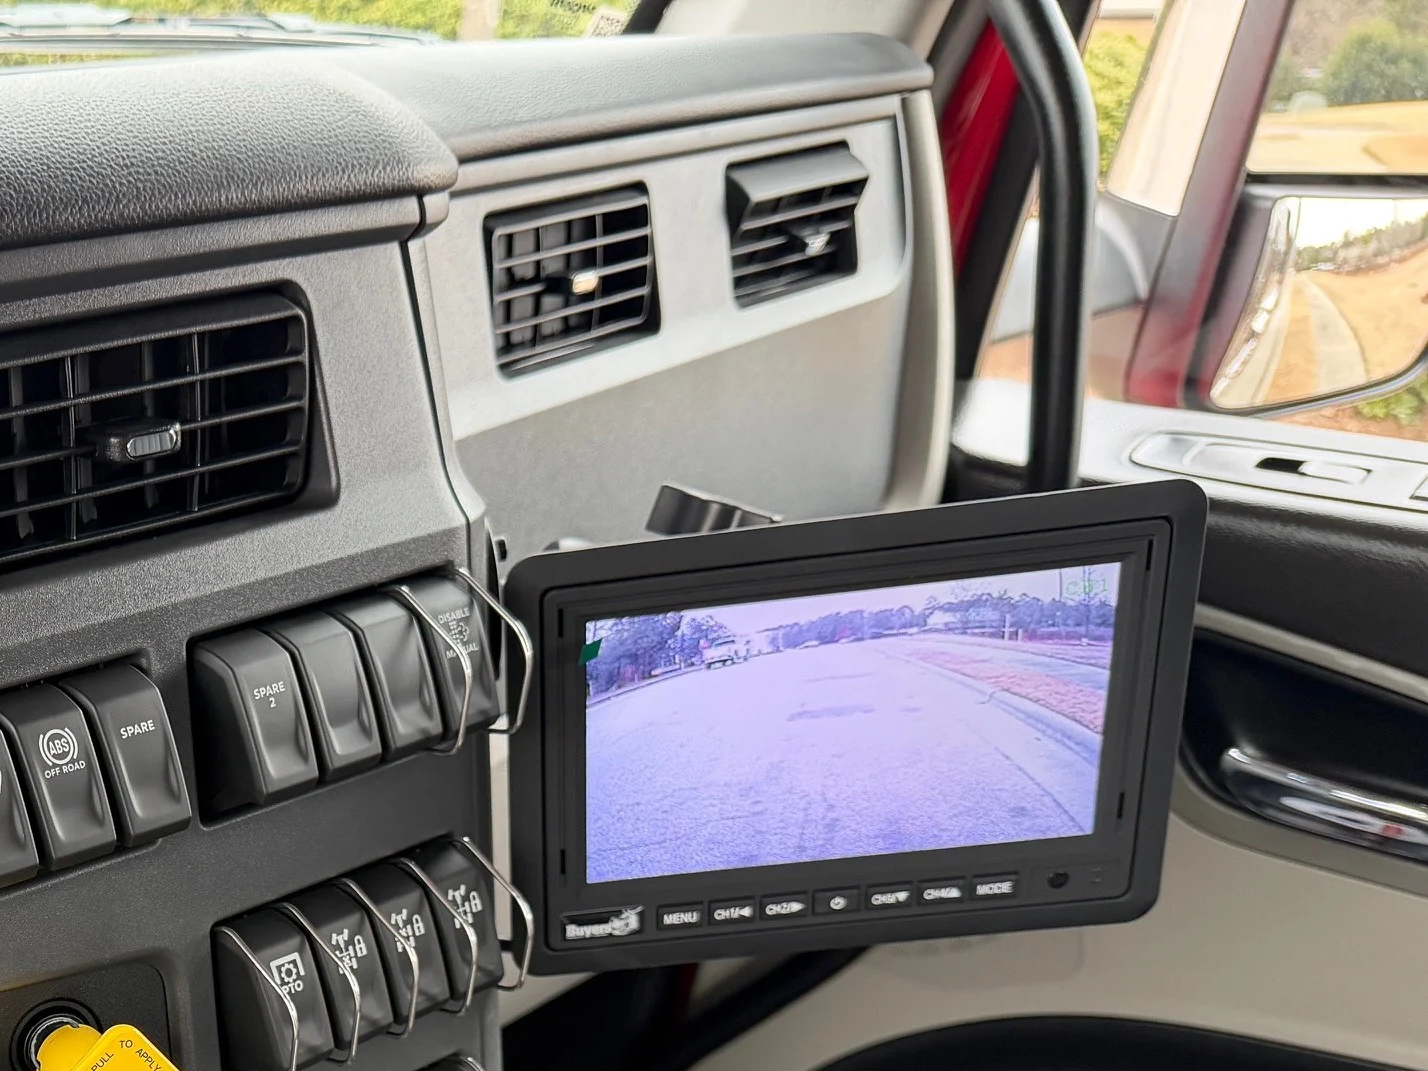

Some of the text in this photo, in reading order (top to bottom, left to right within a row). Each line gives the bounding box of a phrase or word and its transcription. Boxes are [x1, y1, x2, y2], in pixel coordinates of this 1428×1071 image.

[438, 607, 470, 624] DISABLE
[253, 681, 286, 701] SPARE
[269, 697, 277, 708] 2
[120, 720, 156, 739] SPARE
[48, 737, 69, 756] ABS
[44, 760, 86, 779] OFF ROAD
[663, 911, 700, 925] MENU
[282, 980, 303, 994] PTO
[119, 1039, 133, 1049] TO
[135, 1048, 161, 1071] APPLY
